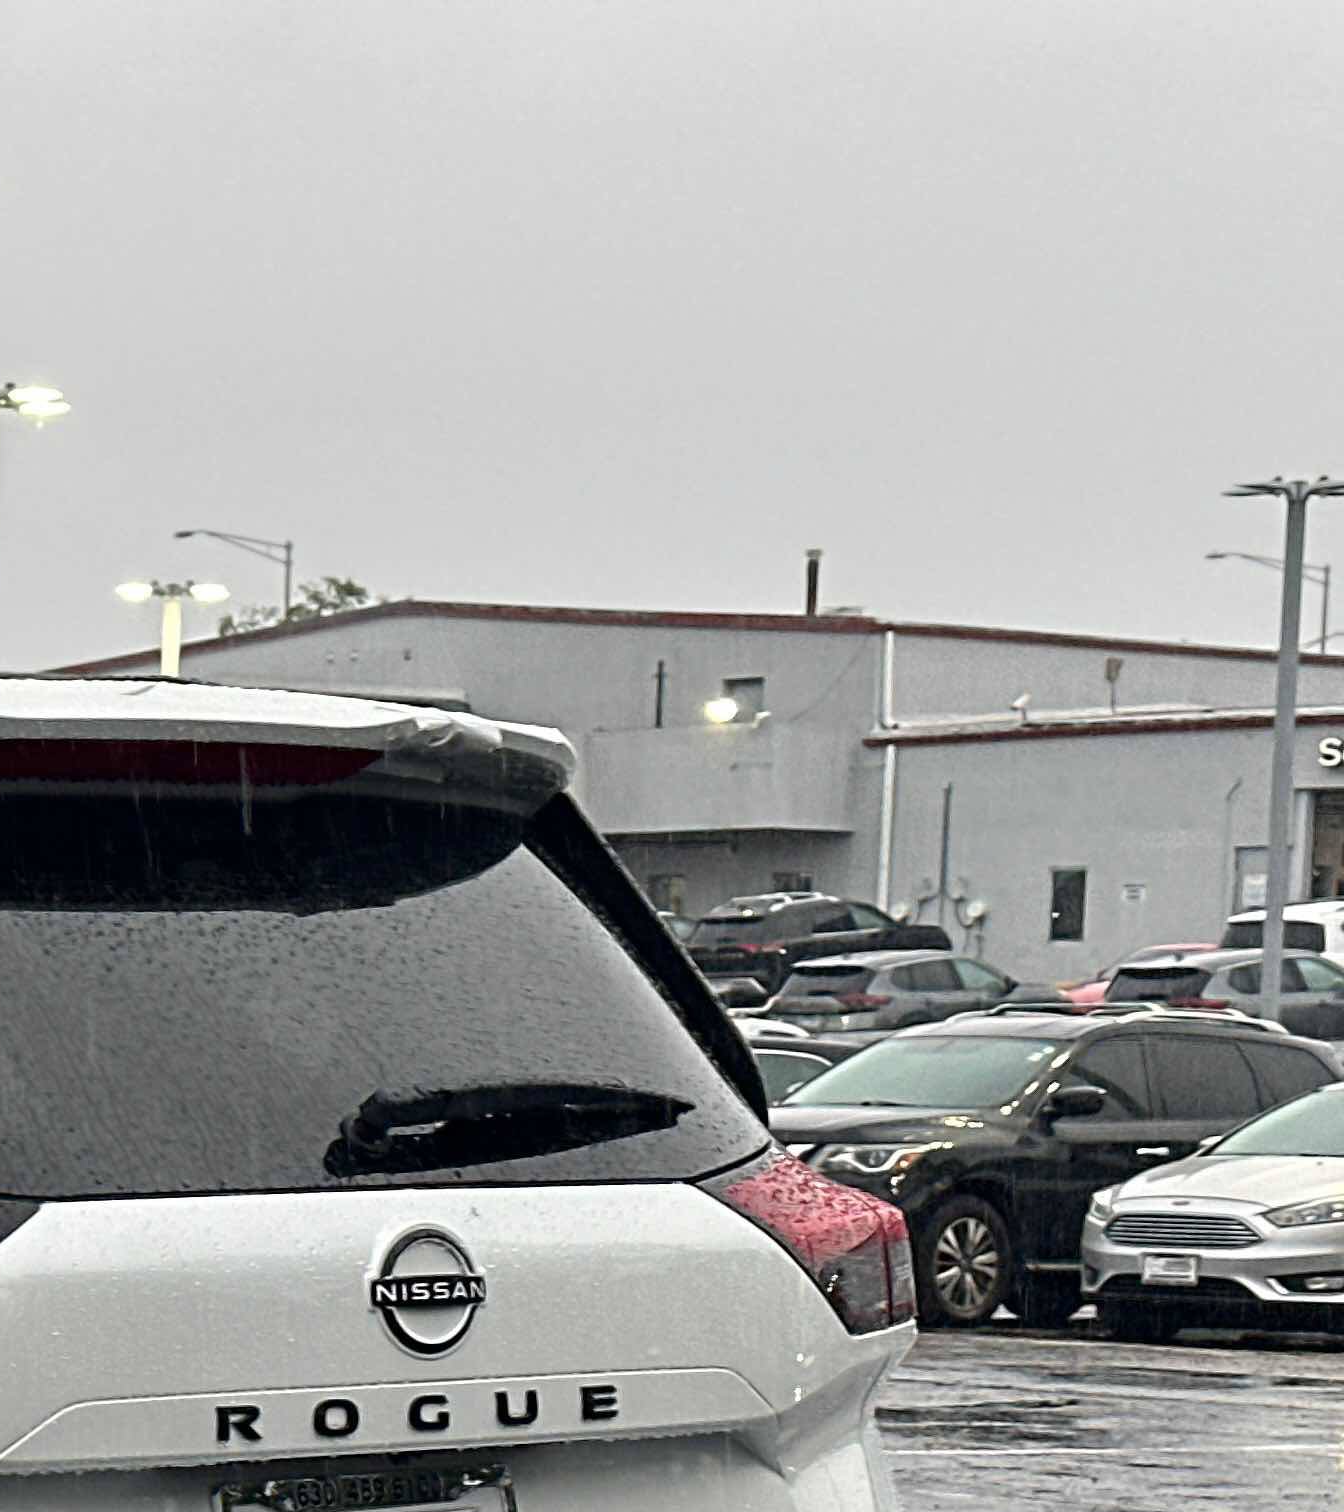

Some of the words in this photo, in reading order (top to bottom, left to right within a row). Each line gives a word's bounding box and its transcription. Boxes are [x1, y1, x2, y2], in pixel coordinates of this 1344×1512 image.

[1318, 737, 1344, 766] S
[375, 1279, 486, 1303] NISSAN
[216, 1385, 620, 1442] ROGUE
